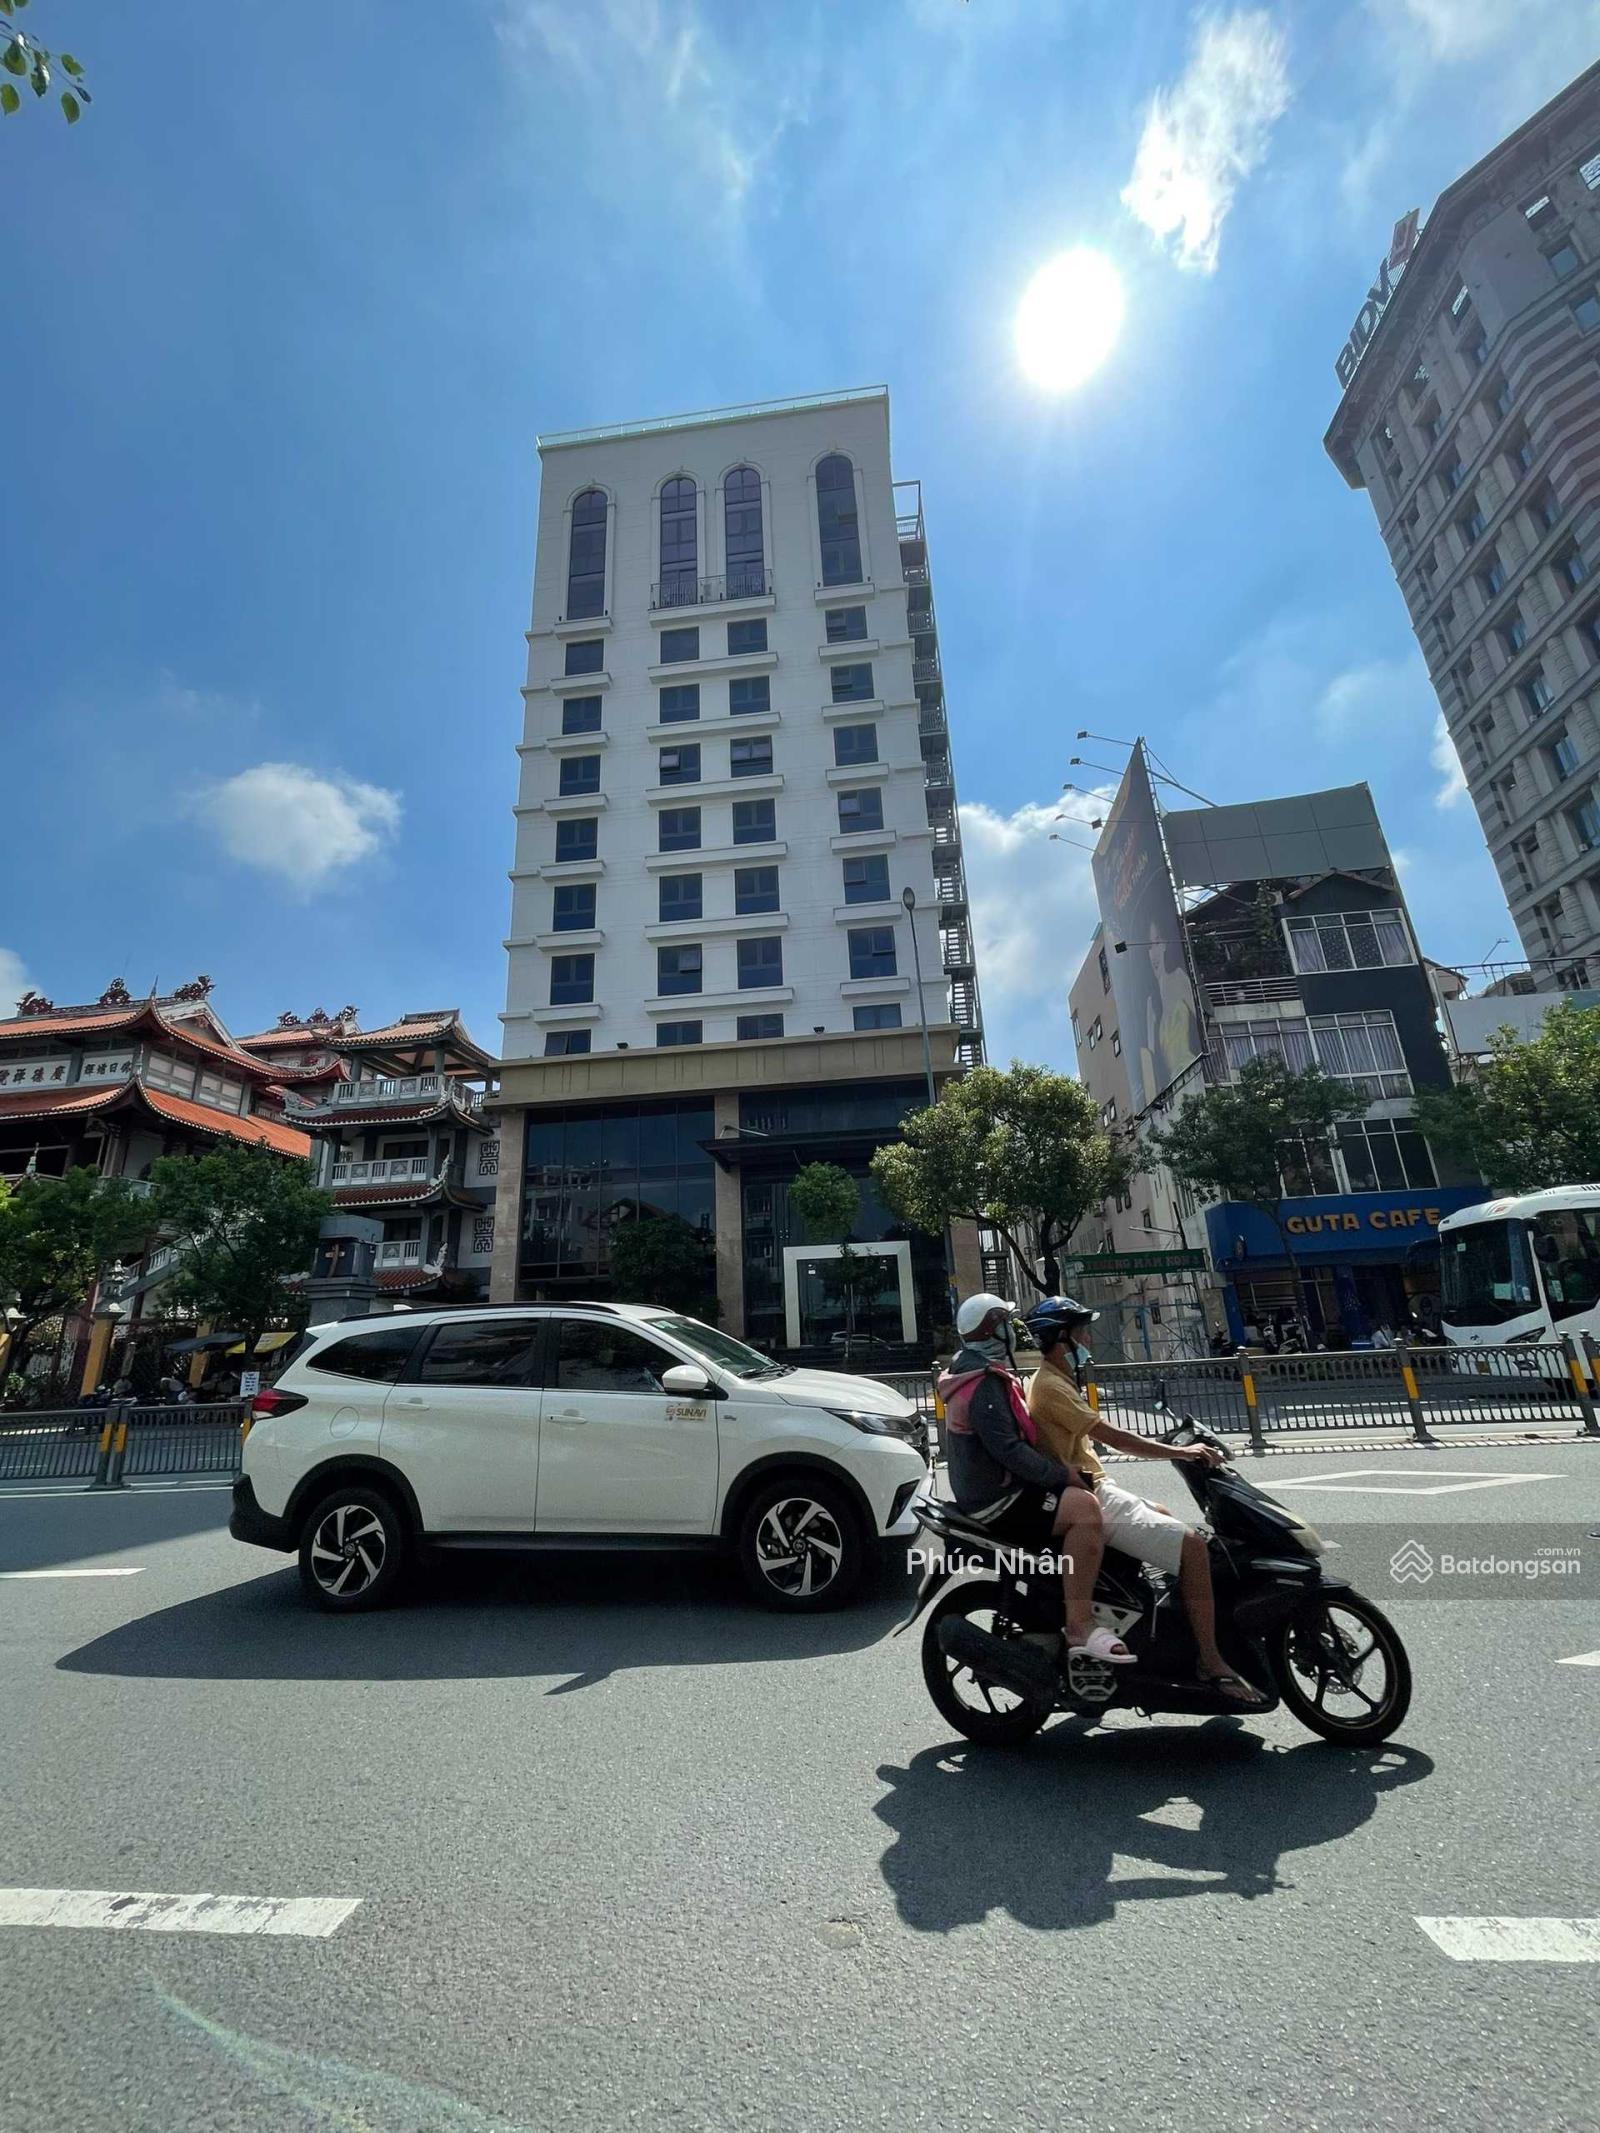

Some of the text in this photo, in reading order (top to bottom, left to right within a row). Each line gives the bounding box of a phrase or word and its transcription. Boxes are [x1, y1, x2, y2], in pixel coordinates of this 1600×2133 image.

[1335, 256, 1395, 390] BIDV
[1286, 1208, 1441, 1234] GUTA CAFE
